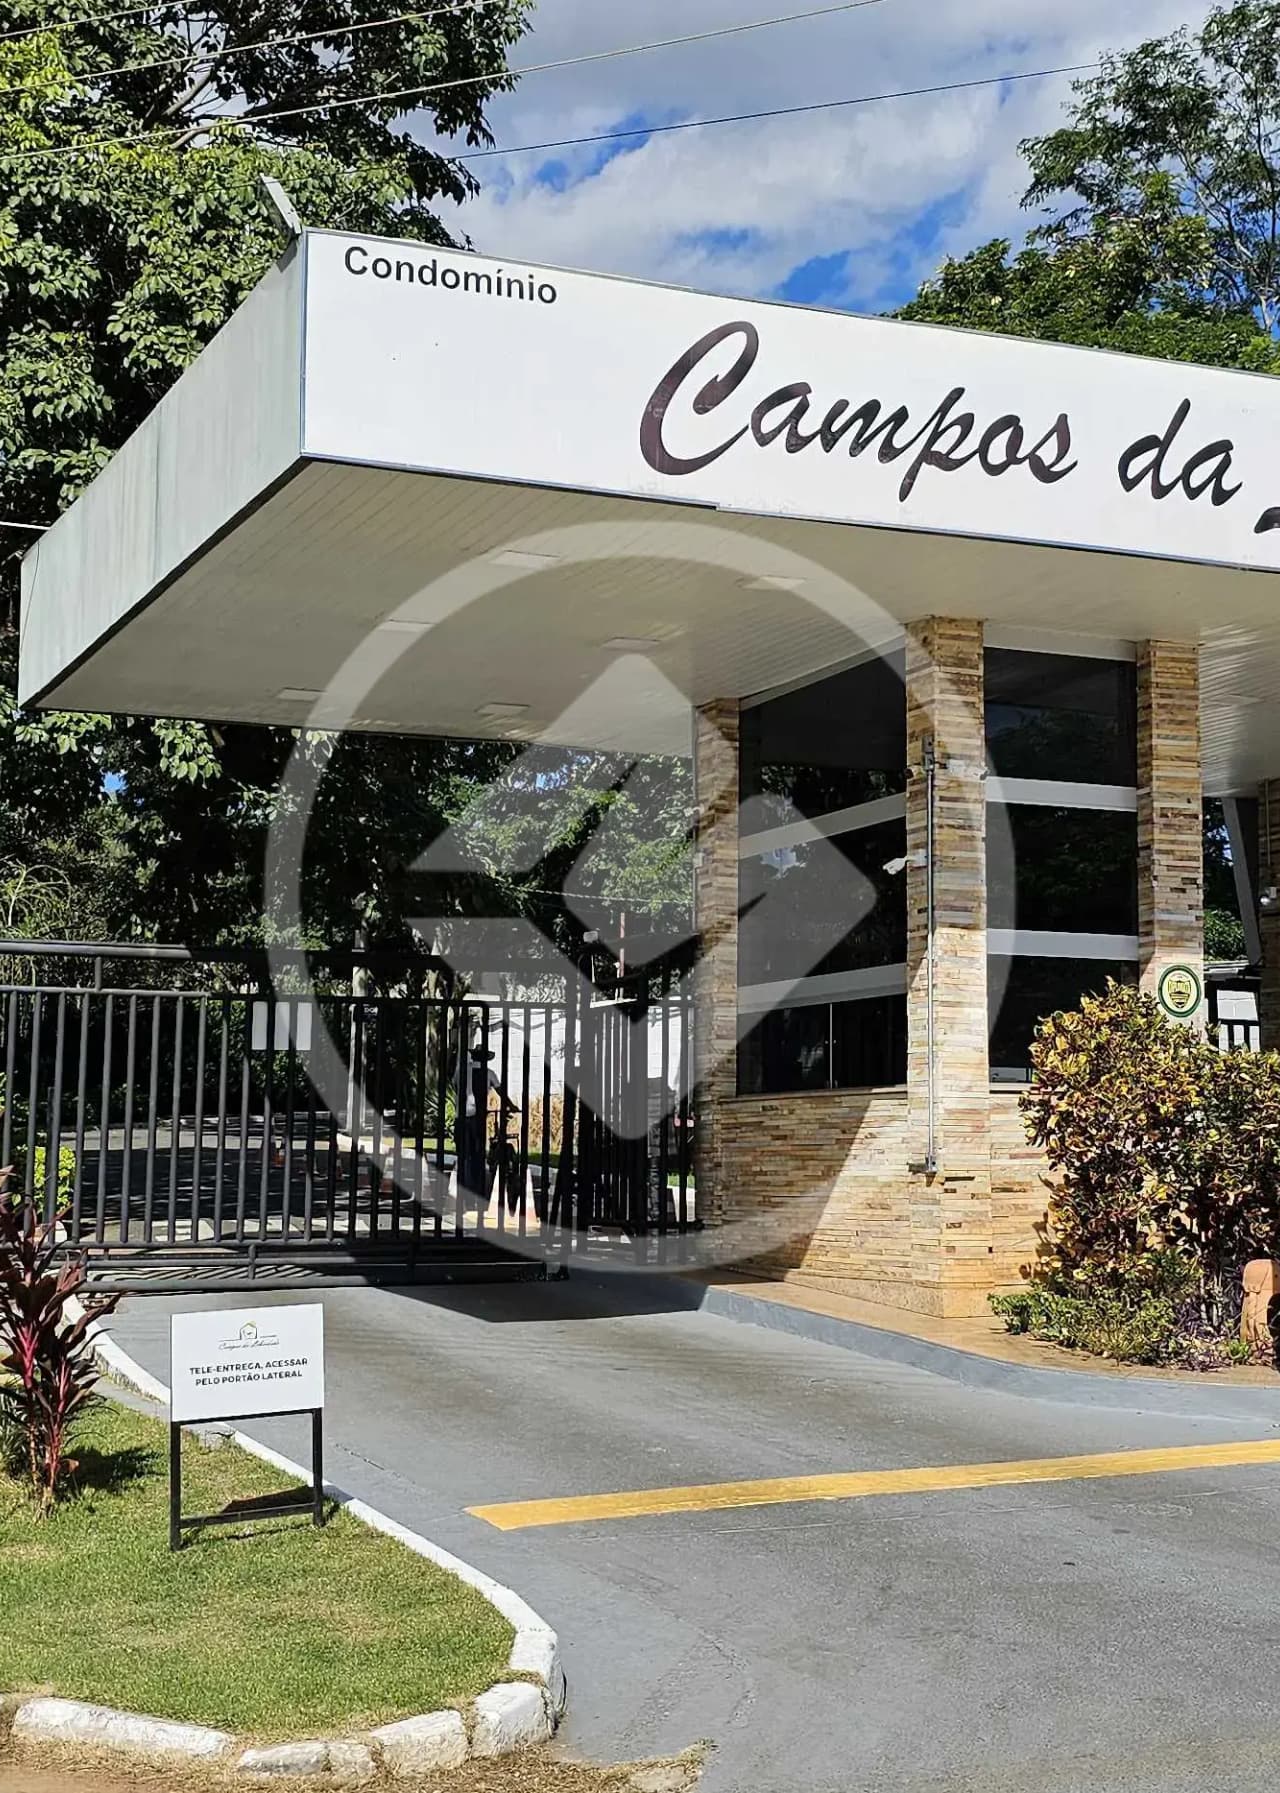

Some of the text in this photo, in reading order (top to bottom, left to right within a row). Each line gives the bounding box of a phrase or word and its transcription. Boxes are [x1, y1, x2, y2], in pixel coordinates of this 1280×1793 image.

[344, 245, 558, 305] Condomínio
[639, 320, 1079, 502] Campos
[1118, 398, 1243, 506] da
[195, 1370, 303, 1387] PELO PORTÃO LATERAL
[265, 1357, 308, 1368] ACESSAR
